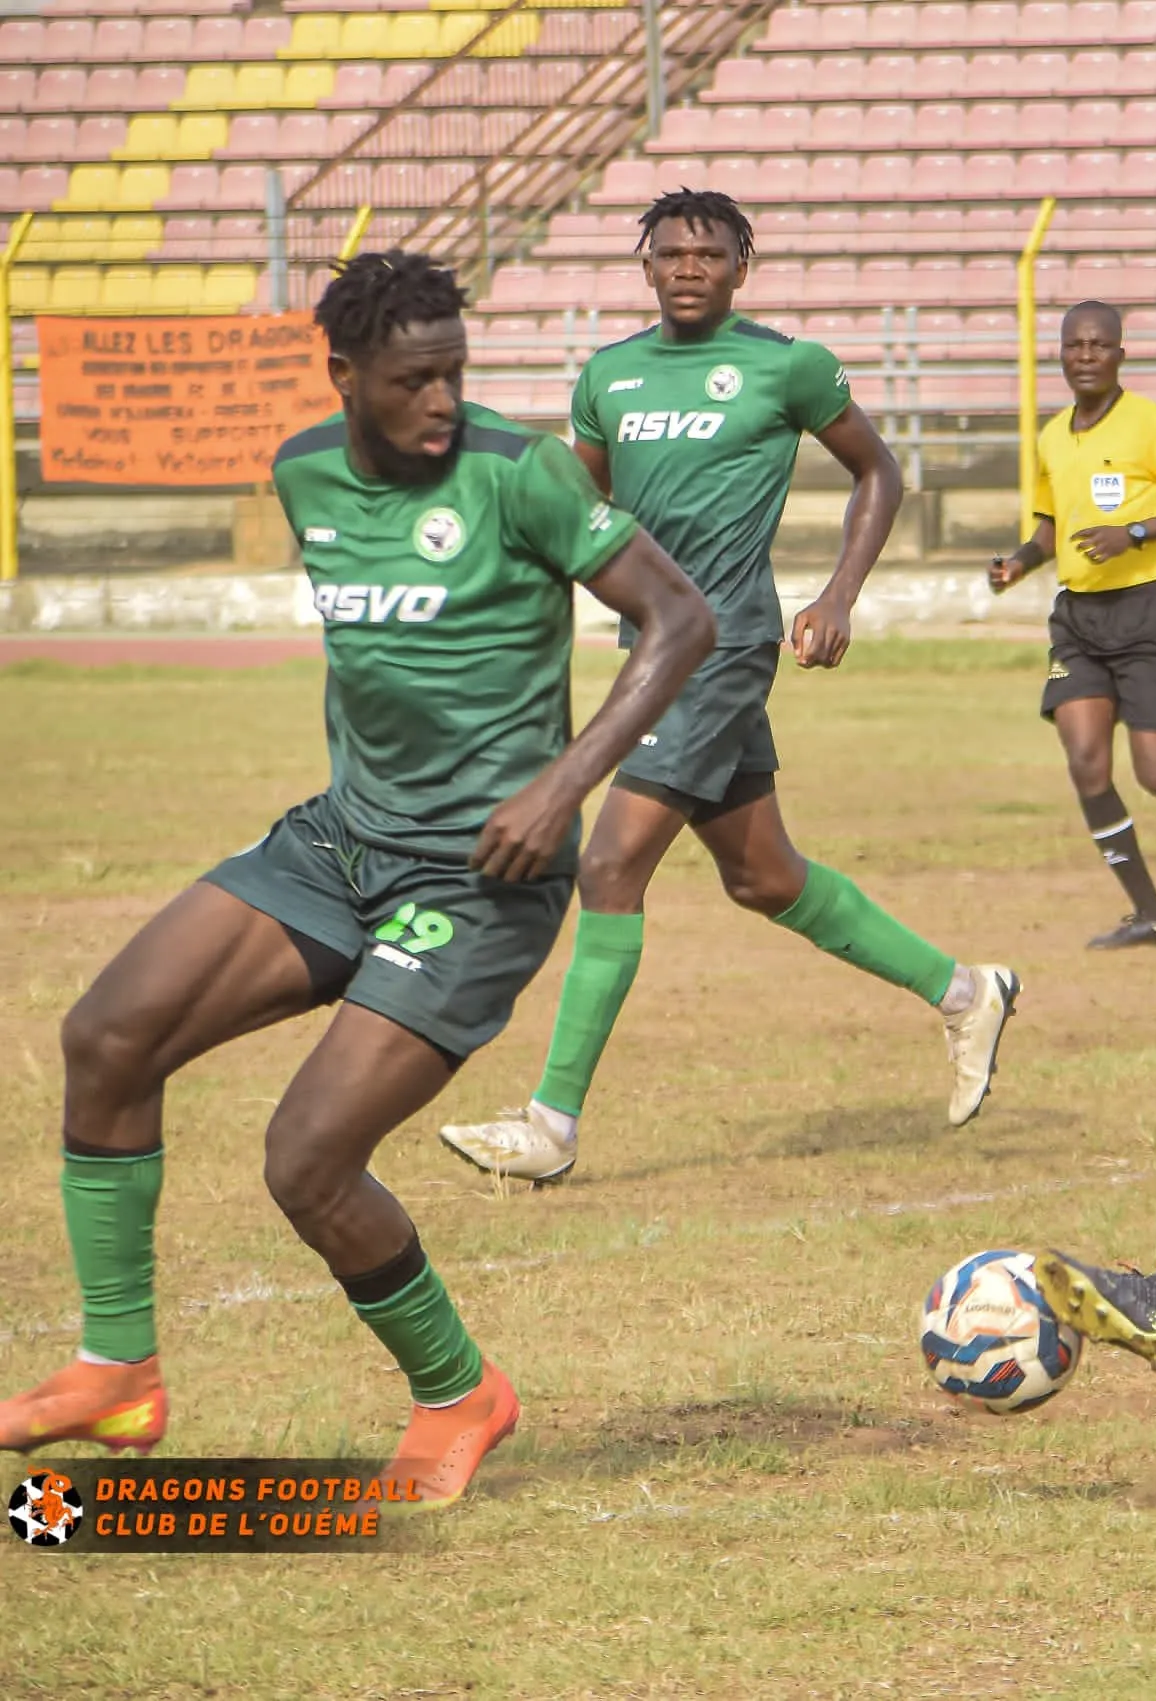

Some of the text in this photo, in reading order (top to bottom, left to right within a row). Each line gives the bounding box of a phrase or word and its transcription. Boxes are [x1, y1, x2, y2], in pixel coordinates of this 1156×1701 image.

[145, 331, 192, 354] LES
[617, 411, 726, 443] ASVO
[1093, 476, 1121, 488] FIFA
[314, 585, 448, 623] ASVO
